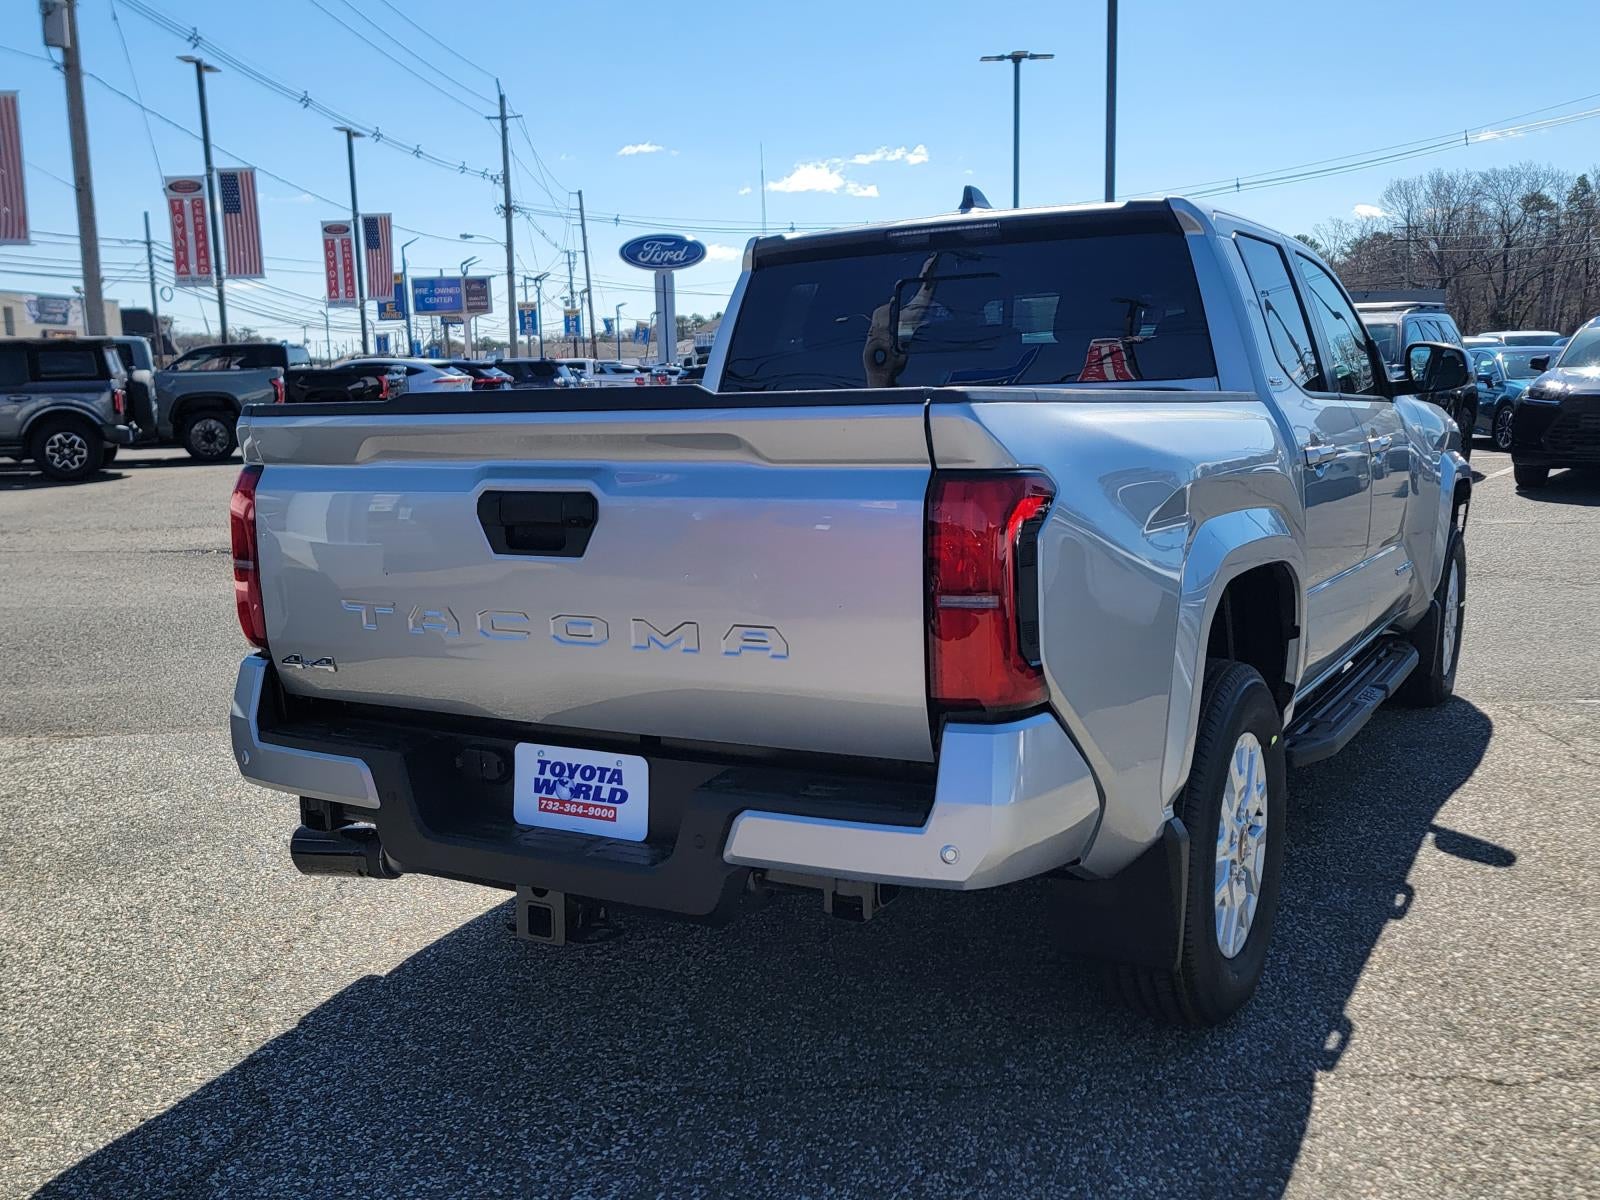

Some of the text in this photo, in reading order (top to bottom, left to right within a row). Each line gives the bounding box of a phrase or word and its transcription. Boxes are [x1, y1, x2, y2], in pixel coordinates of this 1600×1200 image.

[174, 201, 188, 273] TOYOTA
[193, 200, 209, 273] CERTIFIED
[638, 240, 689, 262] Ford
[327, 241, 338, 297] TOYOTA
[343, 240, 354, 298] CERTIFIED
[415, 287, 429, 295] PRE
[424, 296, 453, 304] CENTER
[341, 599, 790, 659] TACOMA
[537, 759, 623, 786] TOYOTA
[540, 799, 615, 819] 732-364-9000
